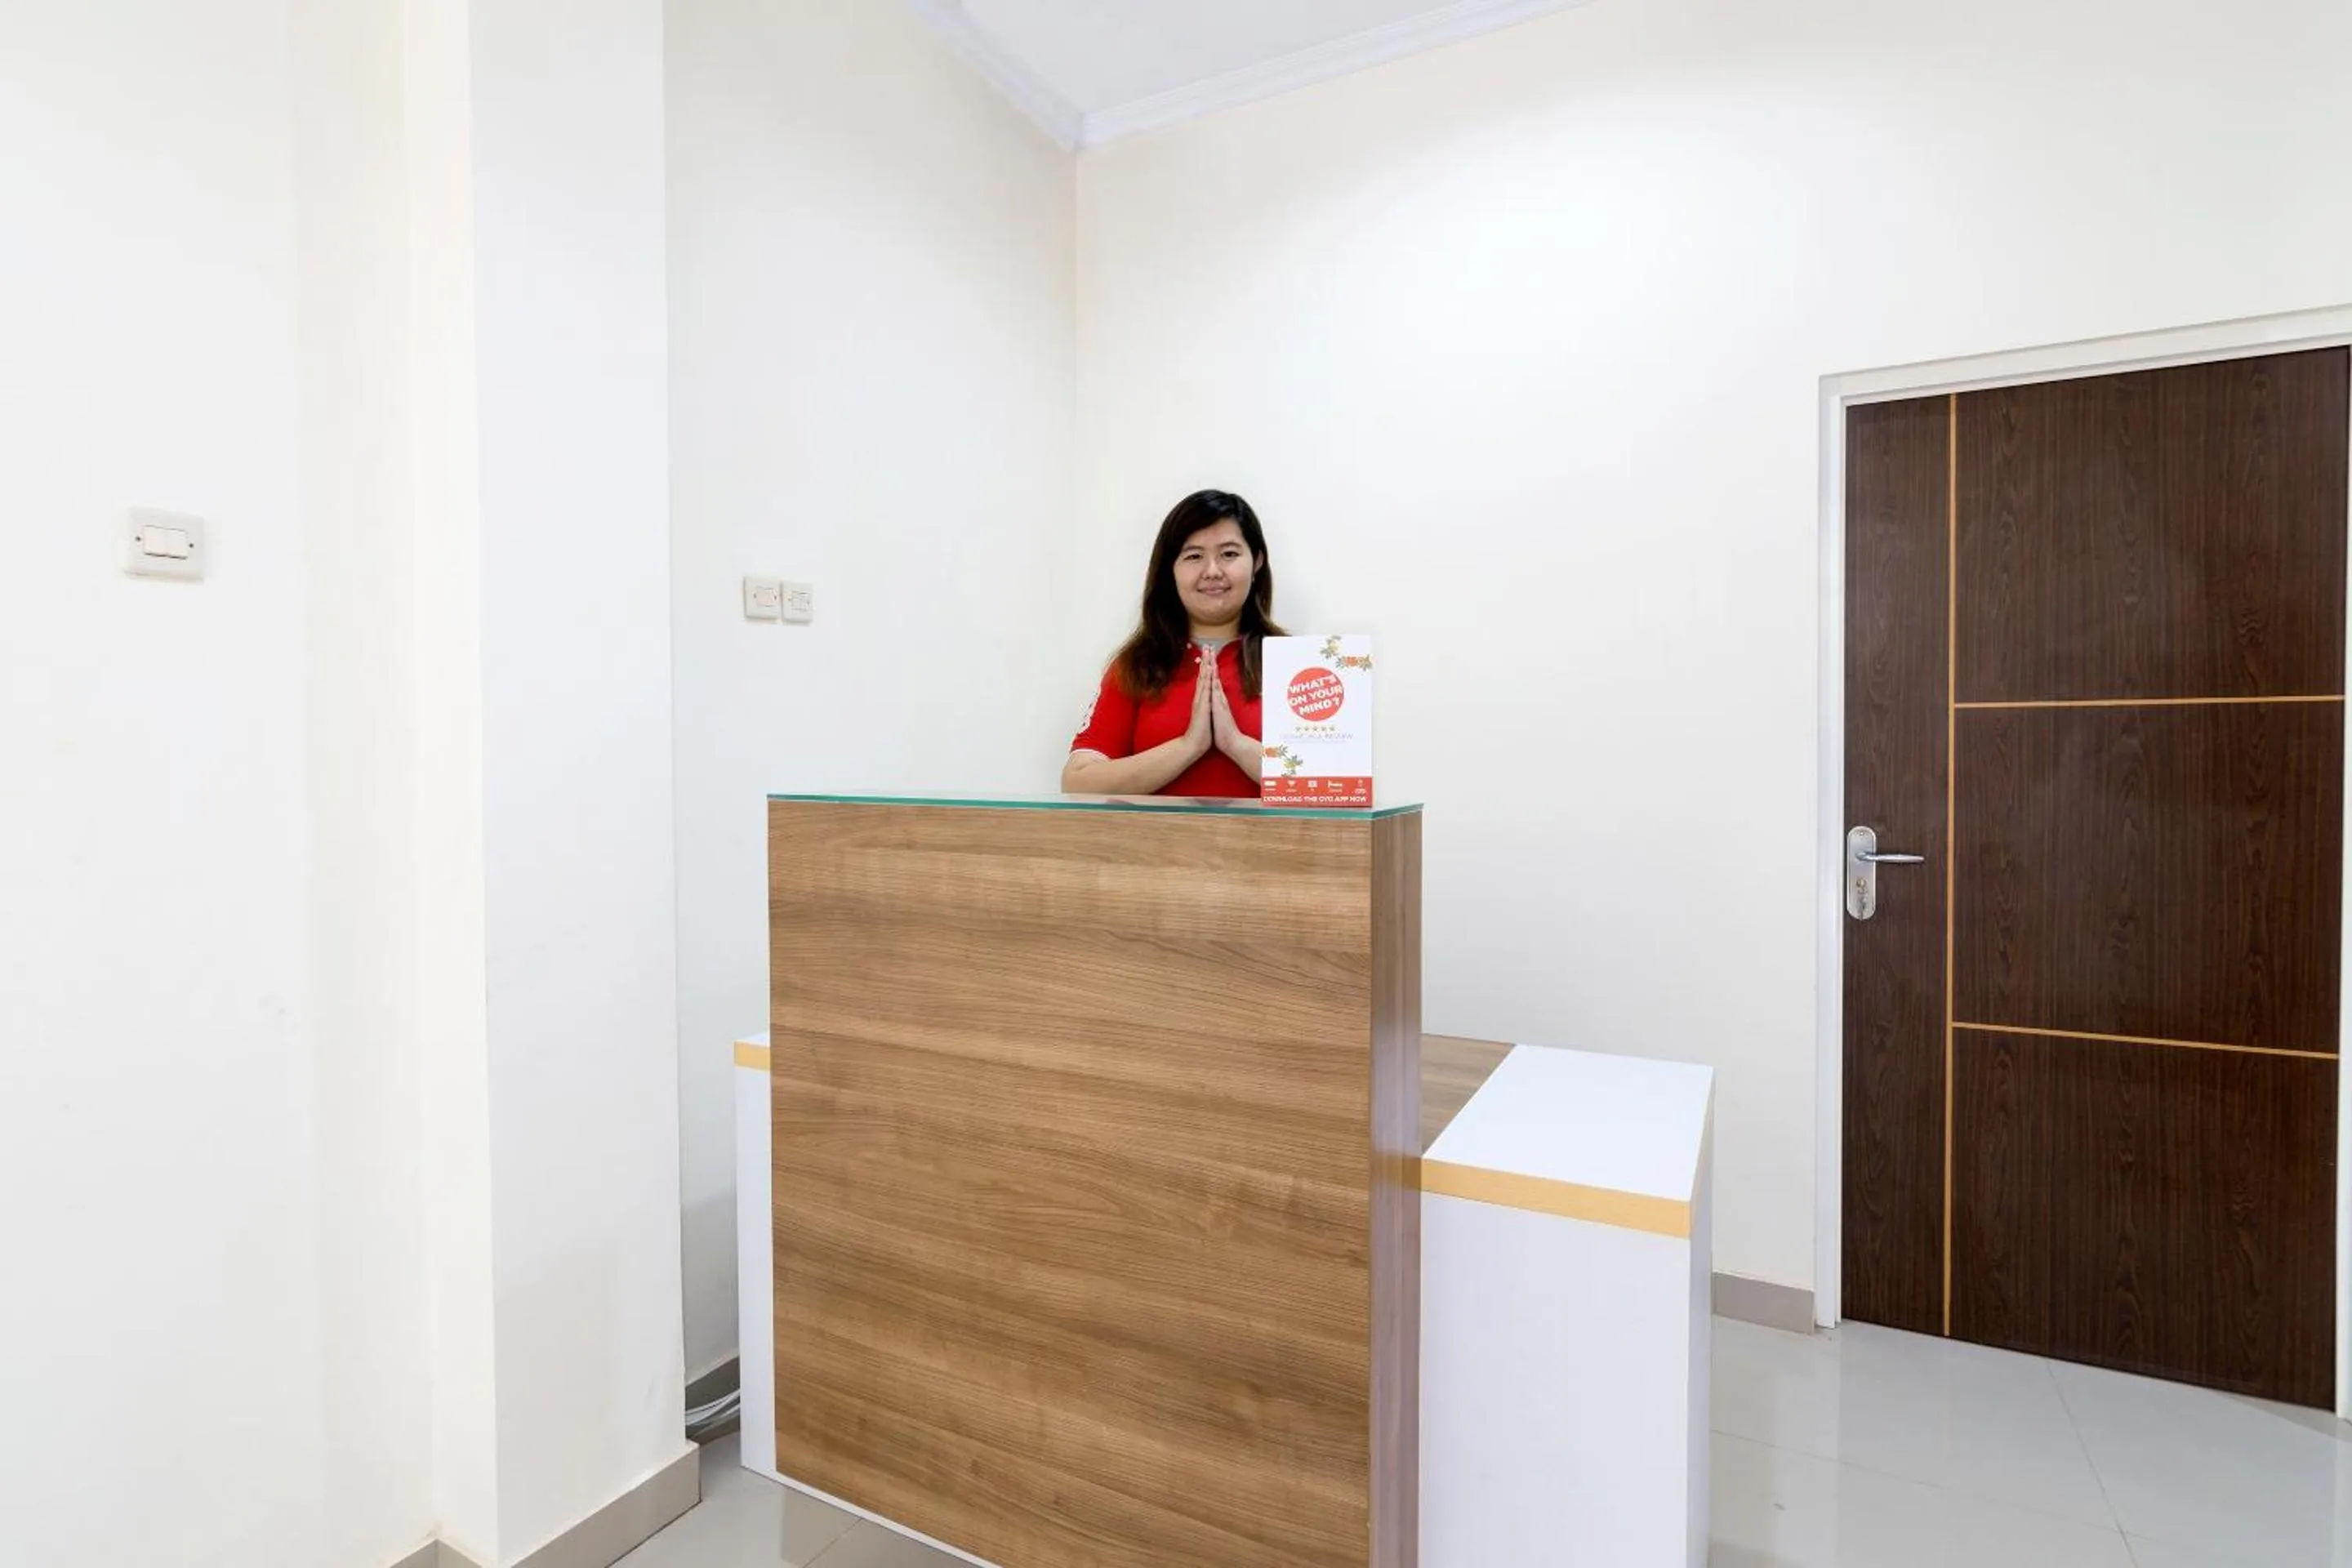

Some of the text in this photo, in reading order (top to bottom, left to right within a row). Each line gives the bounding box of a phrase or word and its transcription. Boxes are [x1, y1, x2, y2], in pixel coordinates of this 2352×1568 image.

[1289, 675, 1338, 693] WHAT'S
[1290, 684, 1343, 706] ON YOUR
[1299, 697, 1340, 715] MIND?
